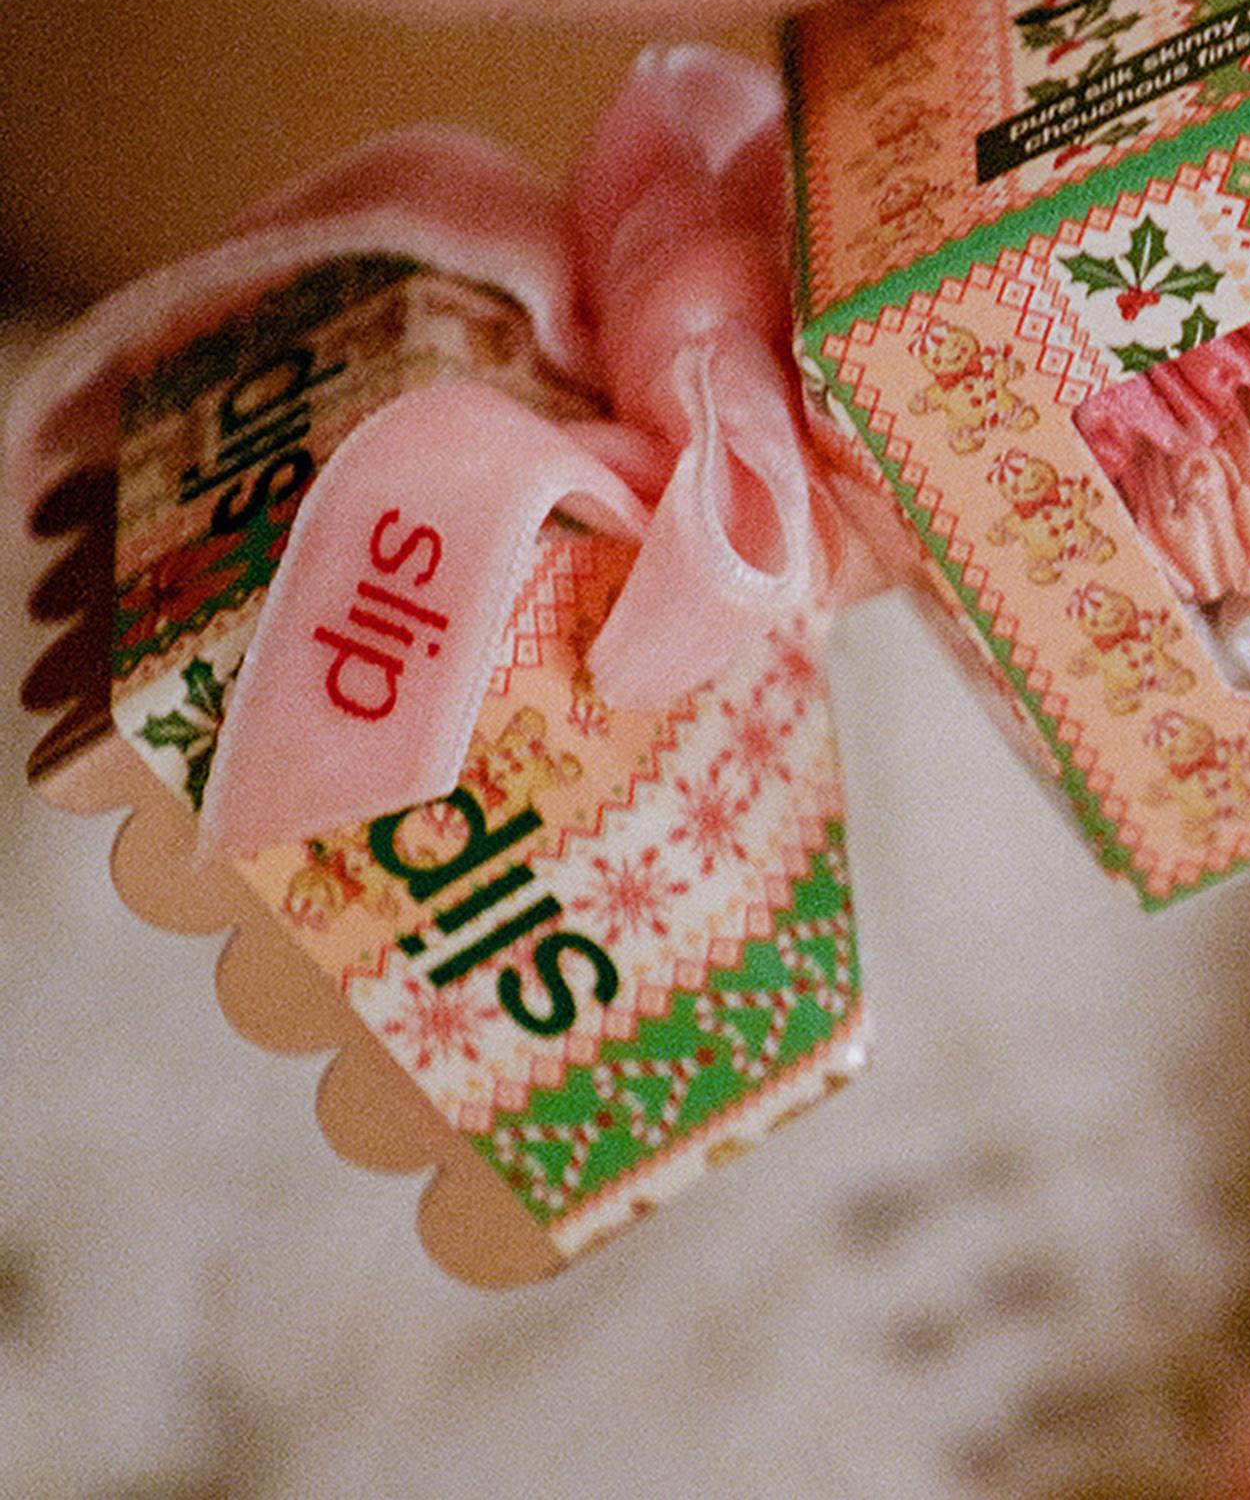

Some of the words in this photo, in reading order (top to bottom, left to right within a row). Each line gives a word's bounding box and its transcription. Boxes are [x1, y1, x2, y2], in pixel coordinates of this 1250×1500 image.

[1009, 96, 1077, 142] pure
[1084, 66, 1134, 100] silk
[1142, 14, 1240, 72] skinny
[1025, 62, 1190, 152] chouchous
[178, 350, 348, 535] slip
[314, 509, 449, 722] slip
[369, 787, 619, 1036] slip
